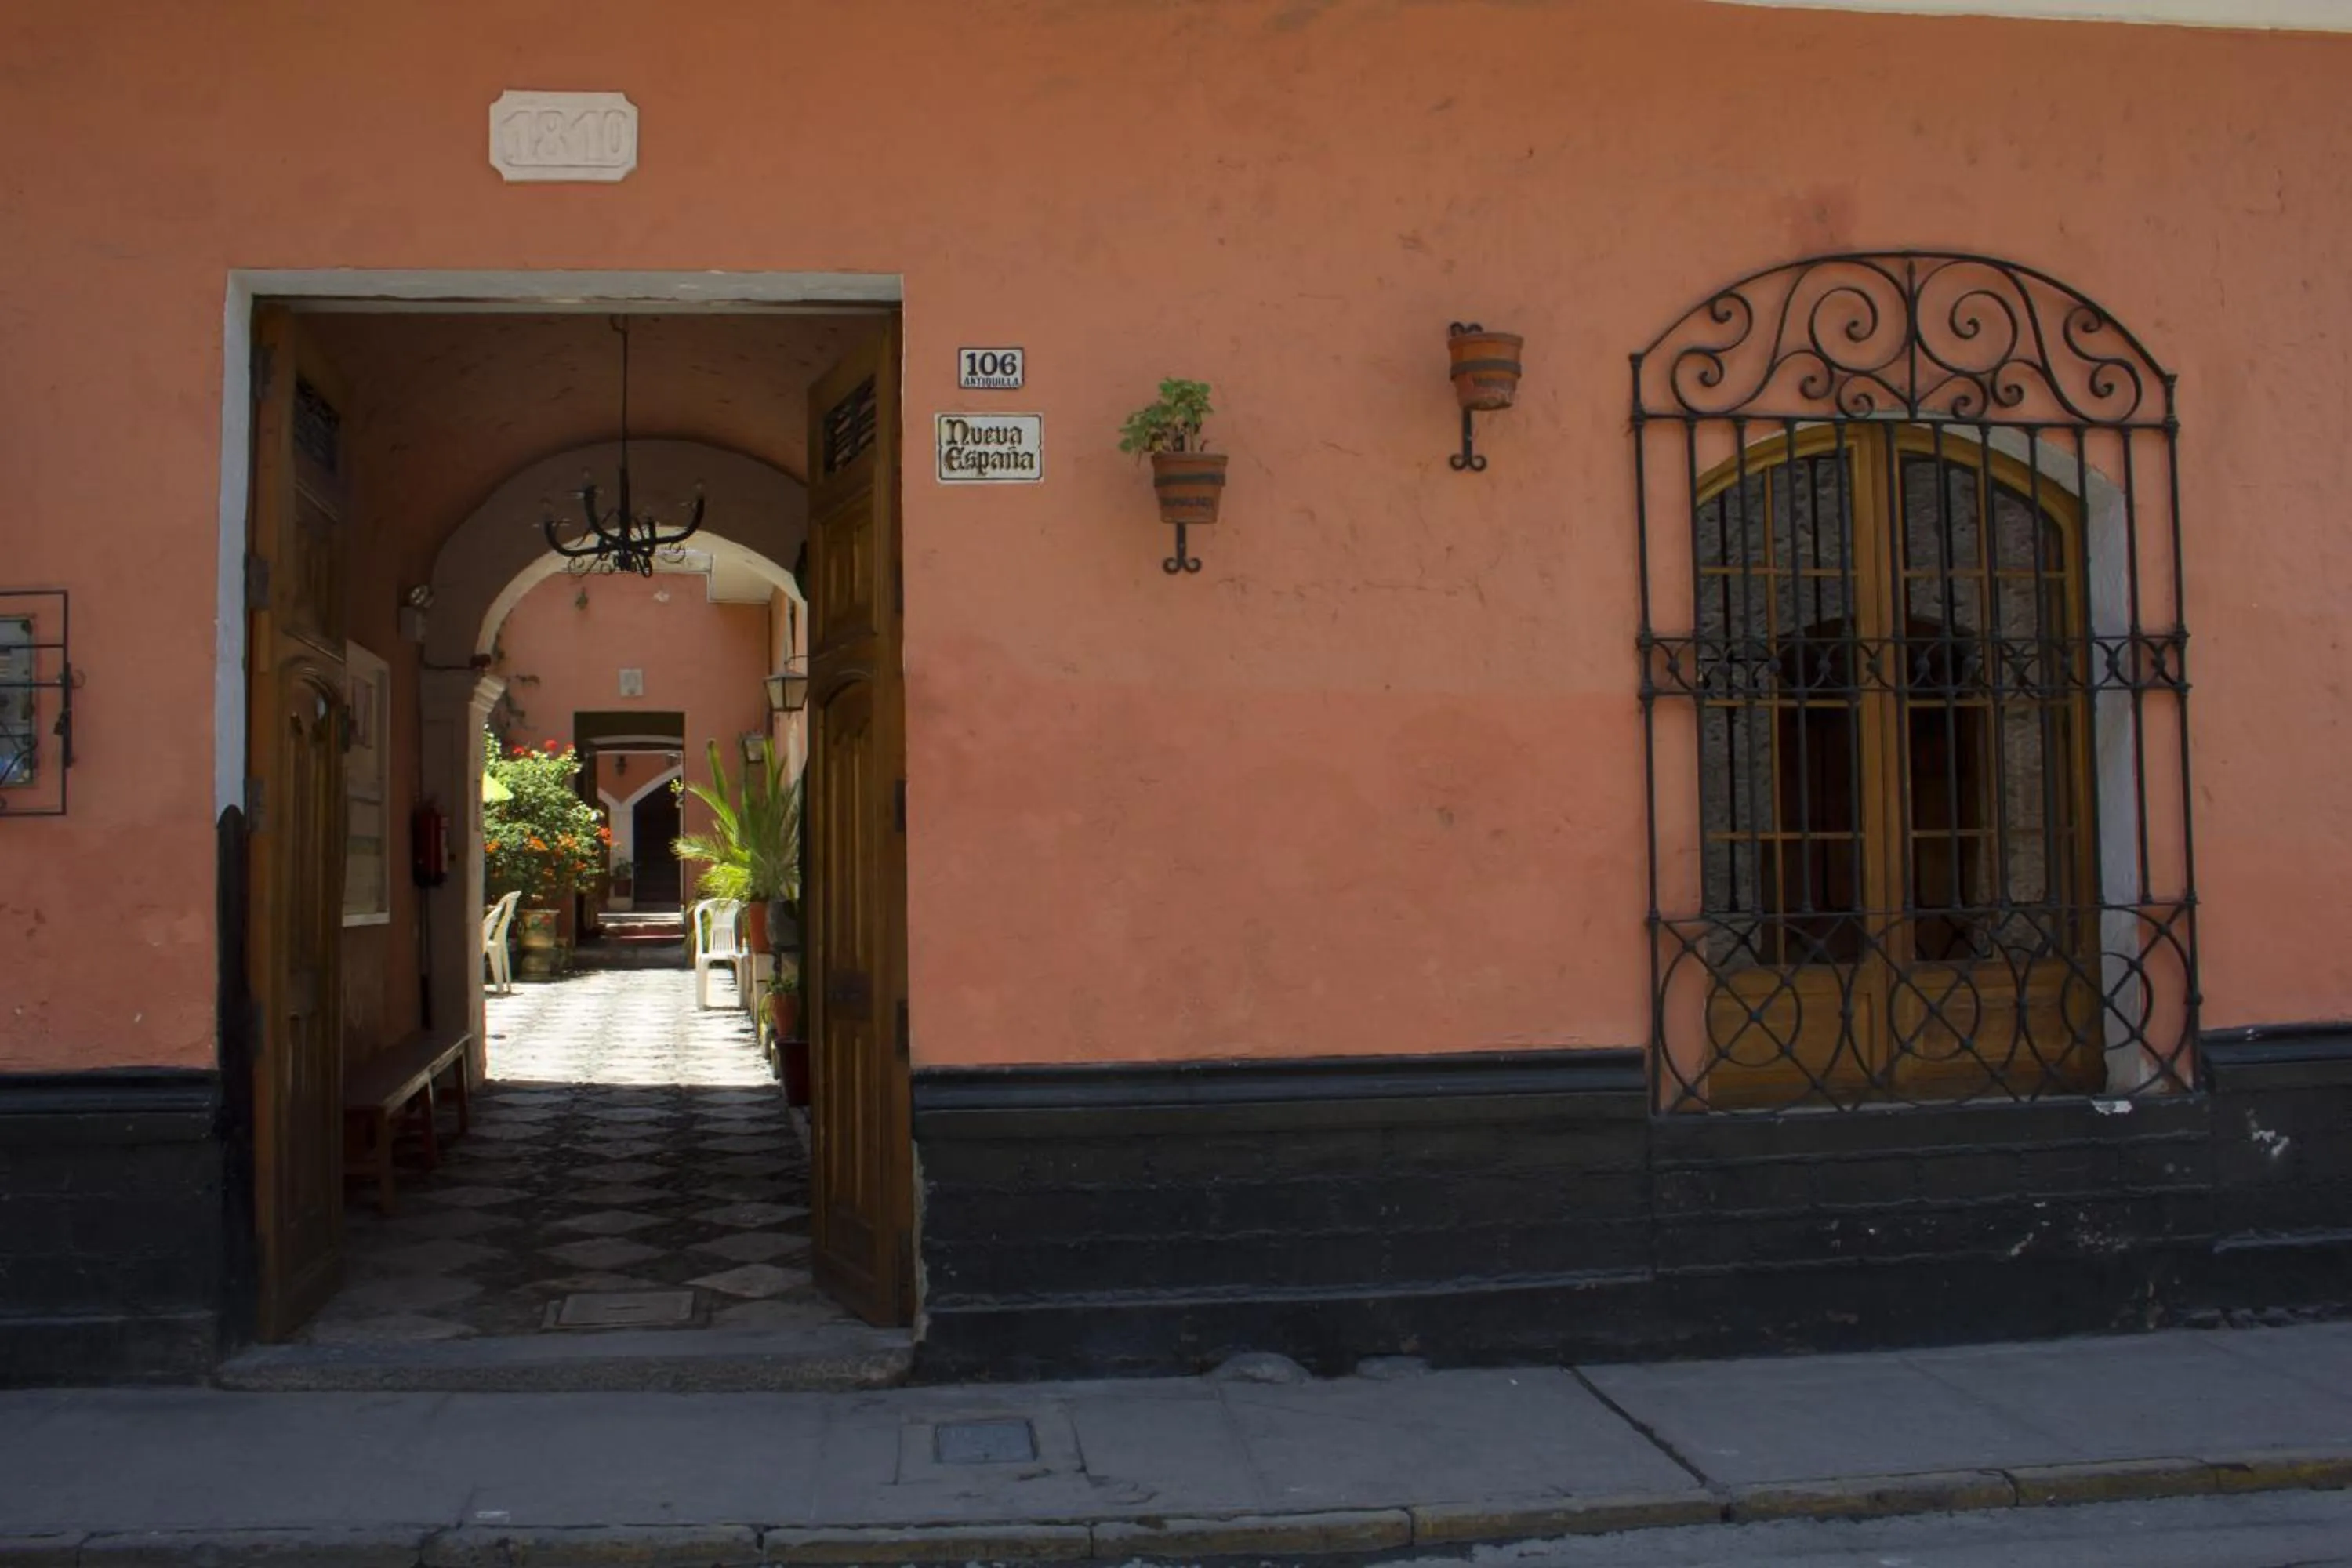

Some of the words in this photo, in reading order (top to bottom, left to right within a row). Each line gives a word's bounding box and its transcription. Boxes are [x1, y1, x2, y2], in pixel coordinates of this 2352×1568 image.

[500, 109, 630, 162] 1810
[965, 351, 1017, 376] 106
[964, 377, 1018, 387] ANTIQUILLA
[946, 419, 1022, 445] Nueva
[945, 446, 1034, 476] España
